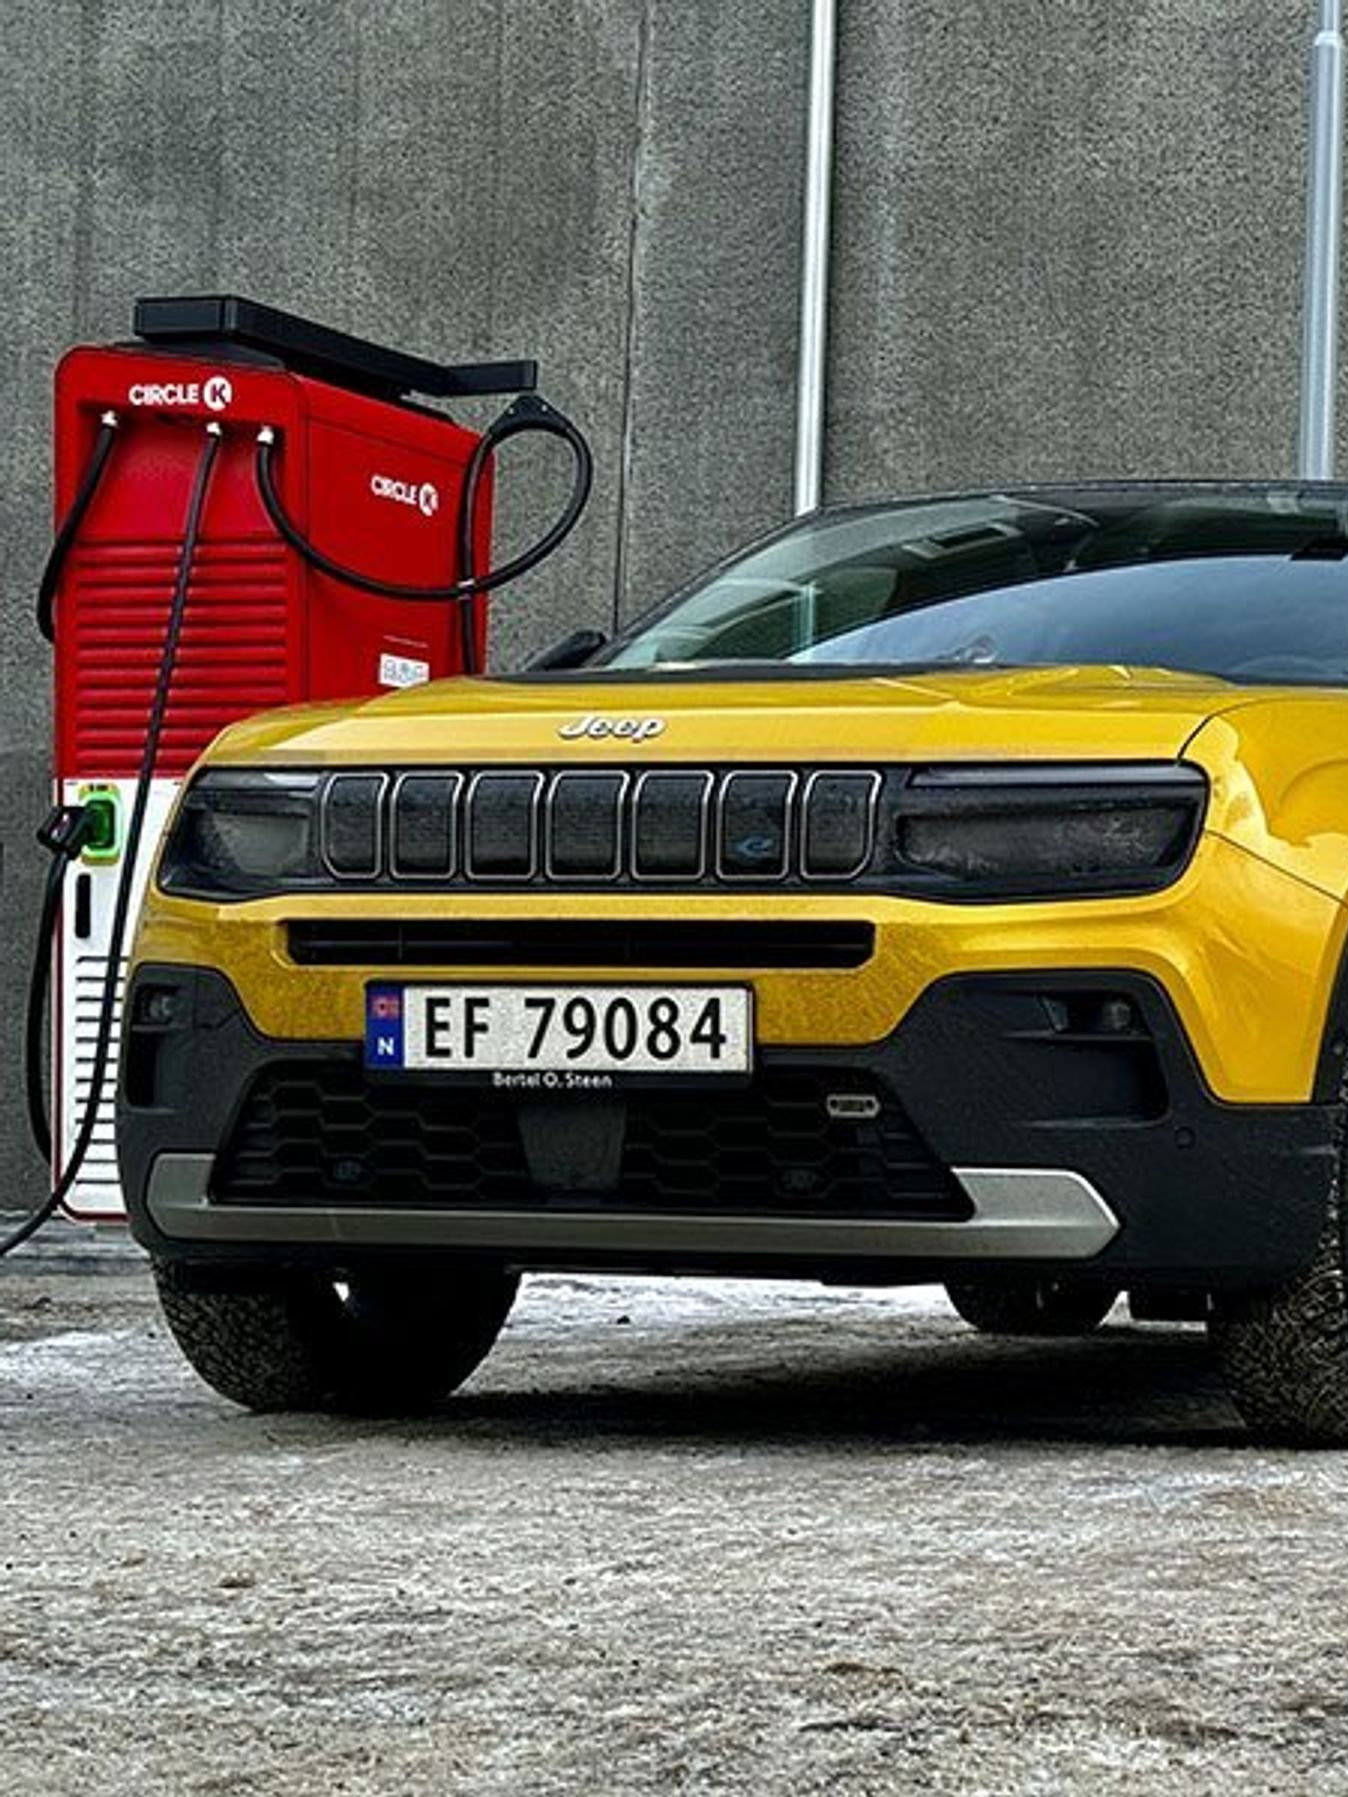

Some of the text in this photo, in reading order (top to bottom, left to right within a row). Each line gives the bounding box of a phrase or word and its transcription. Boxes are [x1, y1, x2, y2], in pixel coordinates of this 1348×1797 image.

[128, 380, 231, 407] CIRCLE K
[371, 475, 417, 505] CIRCLE
[559, 714, 666, 742] Jeep
[425, 996, 728, 1060] EF 79084
[376, 1037, 395, 1056] N
[493, 1071, 612, 1089] Bertel O. Steen
